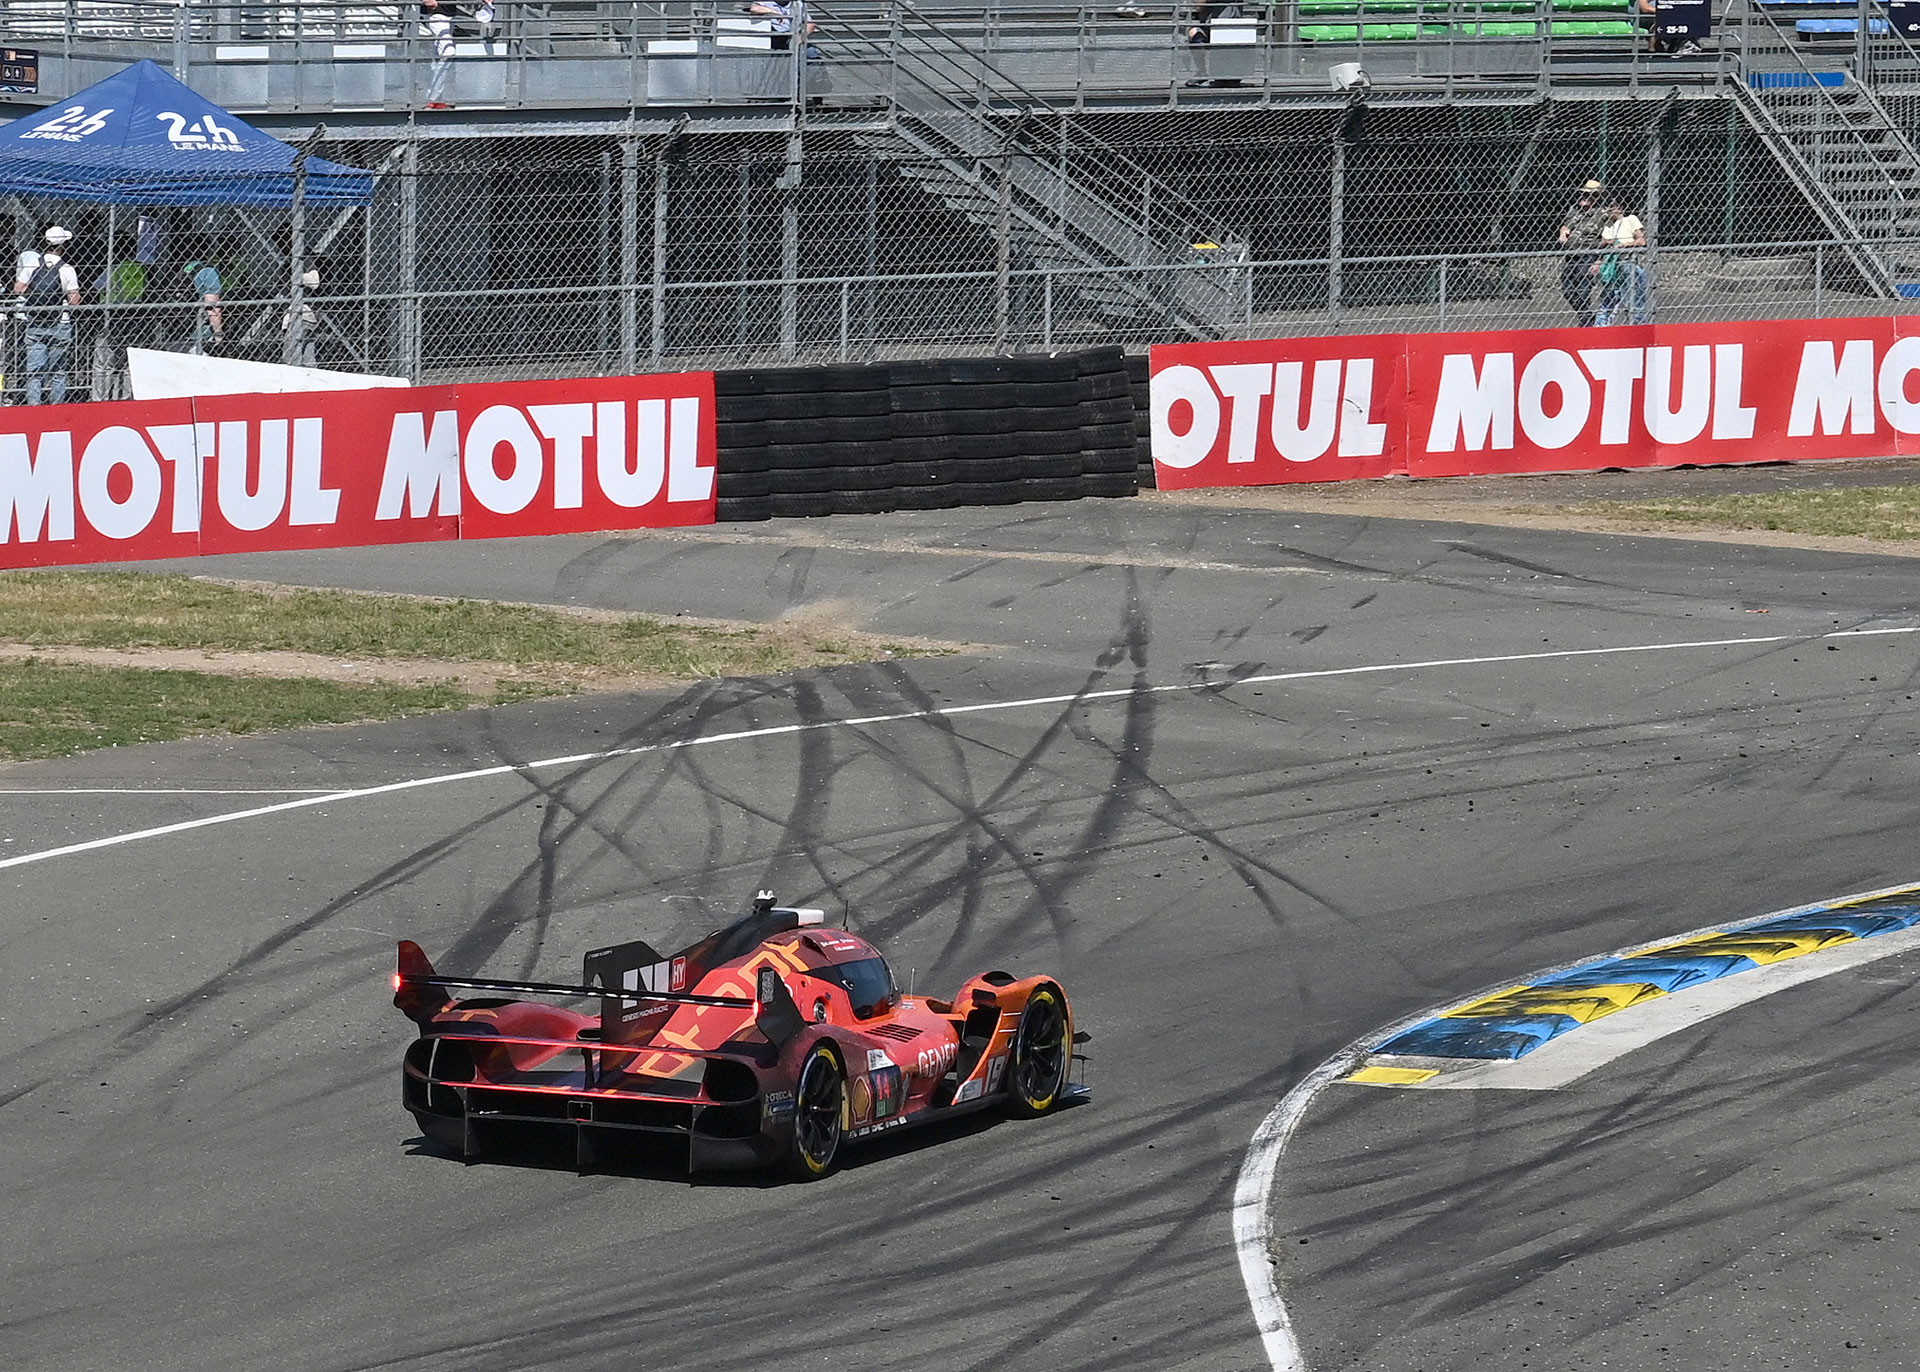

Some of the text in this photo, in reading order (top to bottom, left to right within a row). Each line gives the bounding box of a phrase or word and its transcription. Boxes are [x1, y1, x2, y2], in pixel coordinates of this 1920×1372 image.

[156, 111, 239, 144] 24h
[172, 142, 247, 152] LE MANS
[1150, 358, 1387, 469] OTUL
[1425, 343, 1757, 453] MOTUL
[0, 417, 341, 545] MOTUL
[375, 397, 715, 521] MOTUL
